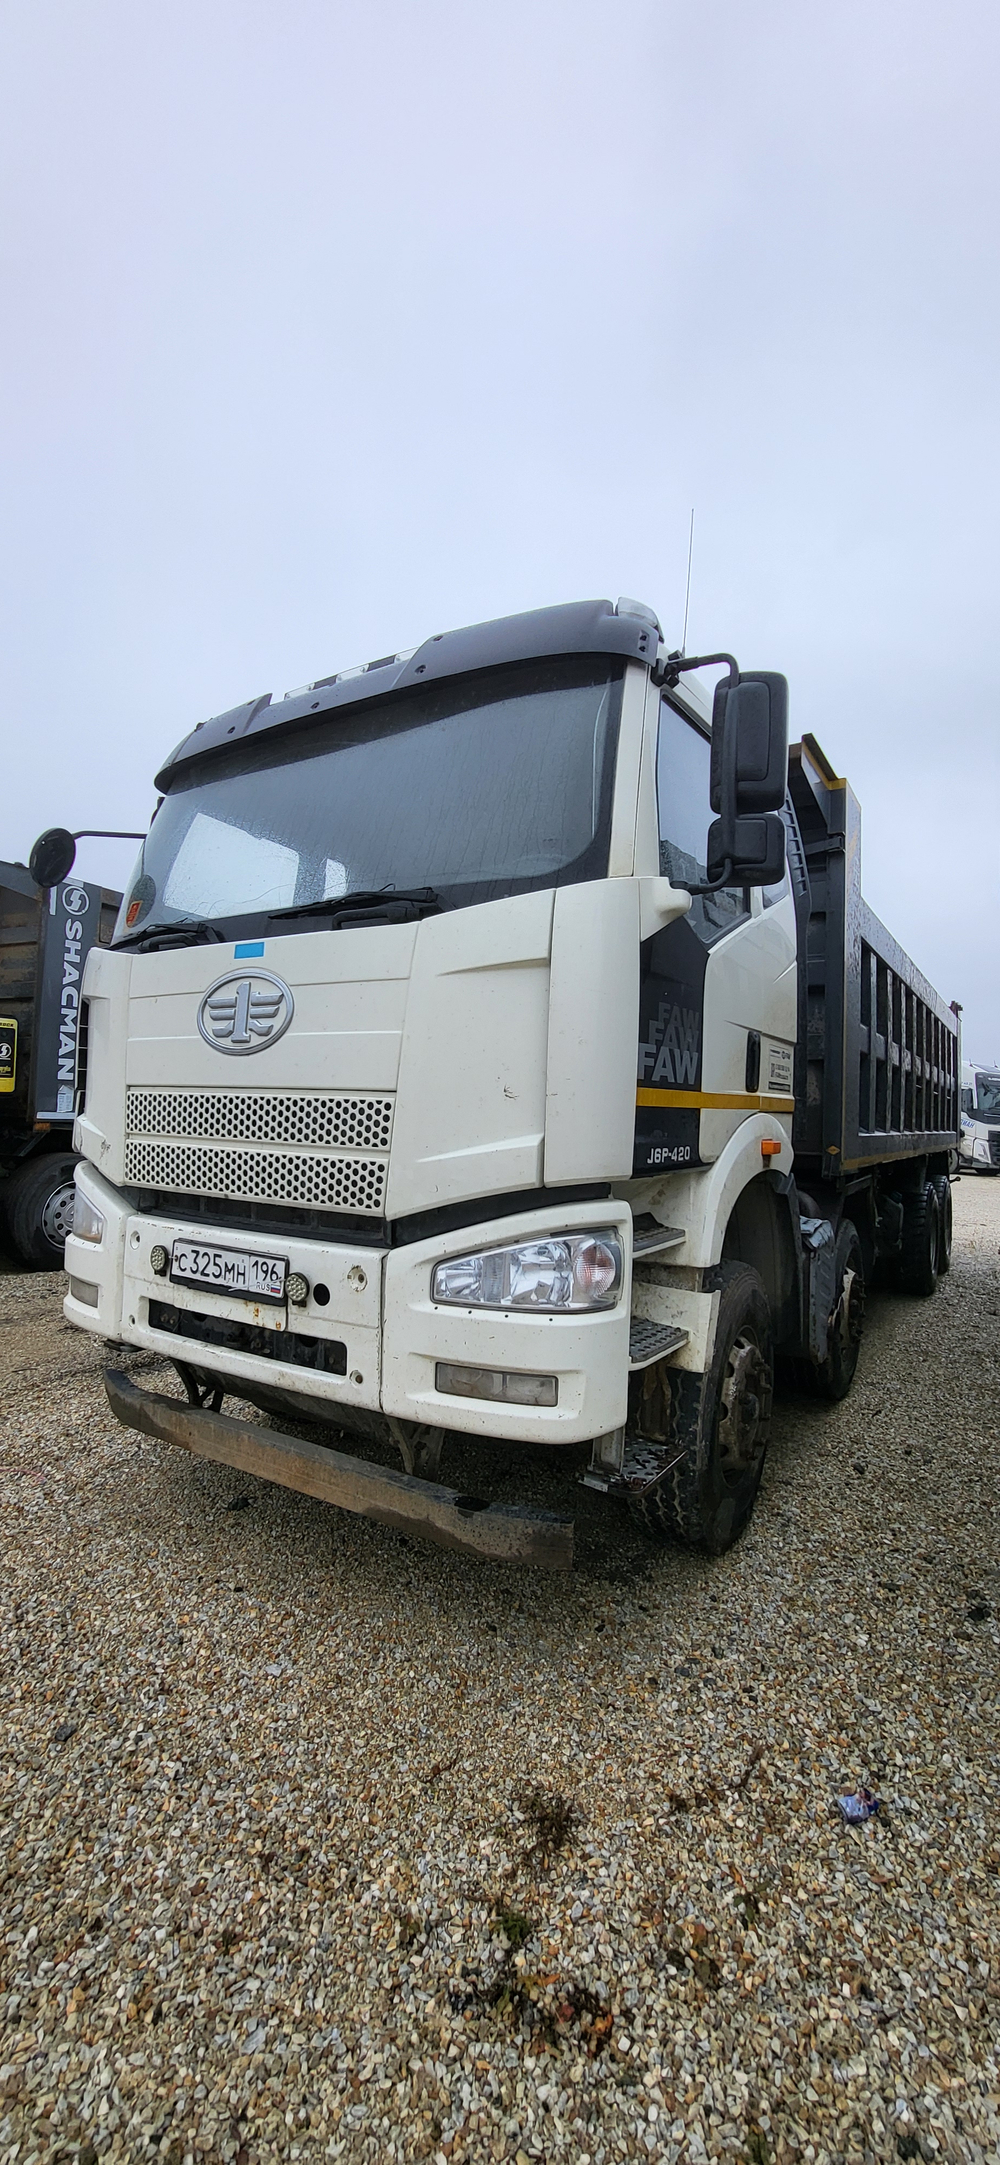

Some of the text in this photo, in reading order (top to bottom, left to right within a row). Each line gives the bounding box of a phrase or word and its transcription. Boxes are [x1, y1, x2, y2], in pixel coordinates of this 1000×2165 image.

[57, 918, 83, 1081] SHACMAN
[658, 1002, 700, 1030] FAW
[649, 1019, 699, 1051] FAW
[637, 1042, 699, 1084] FAW
[646, 1146, 691, 1164] J6P-420
[251, 1260, 280, 1283] 196
[255, 1281, 271, 1292] RUS
